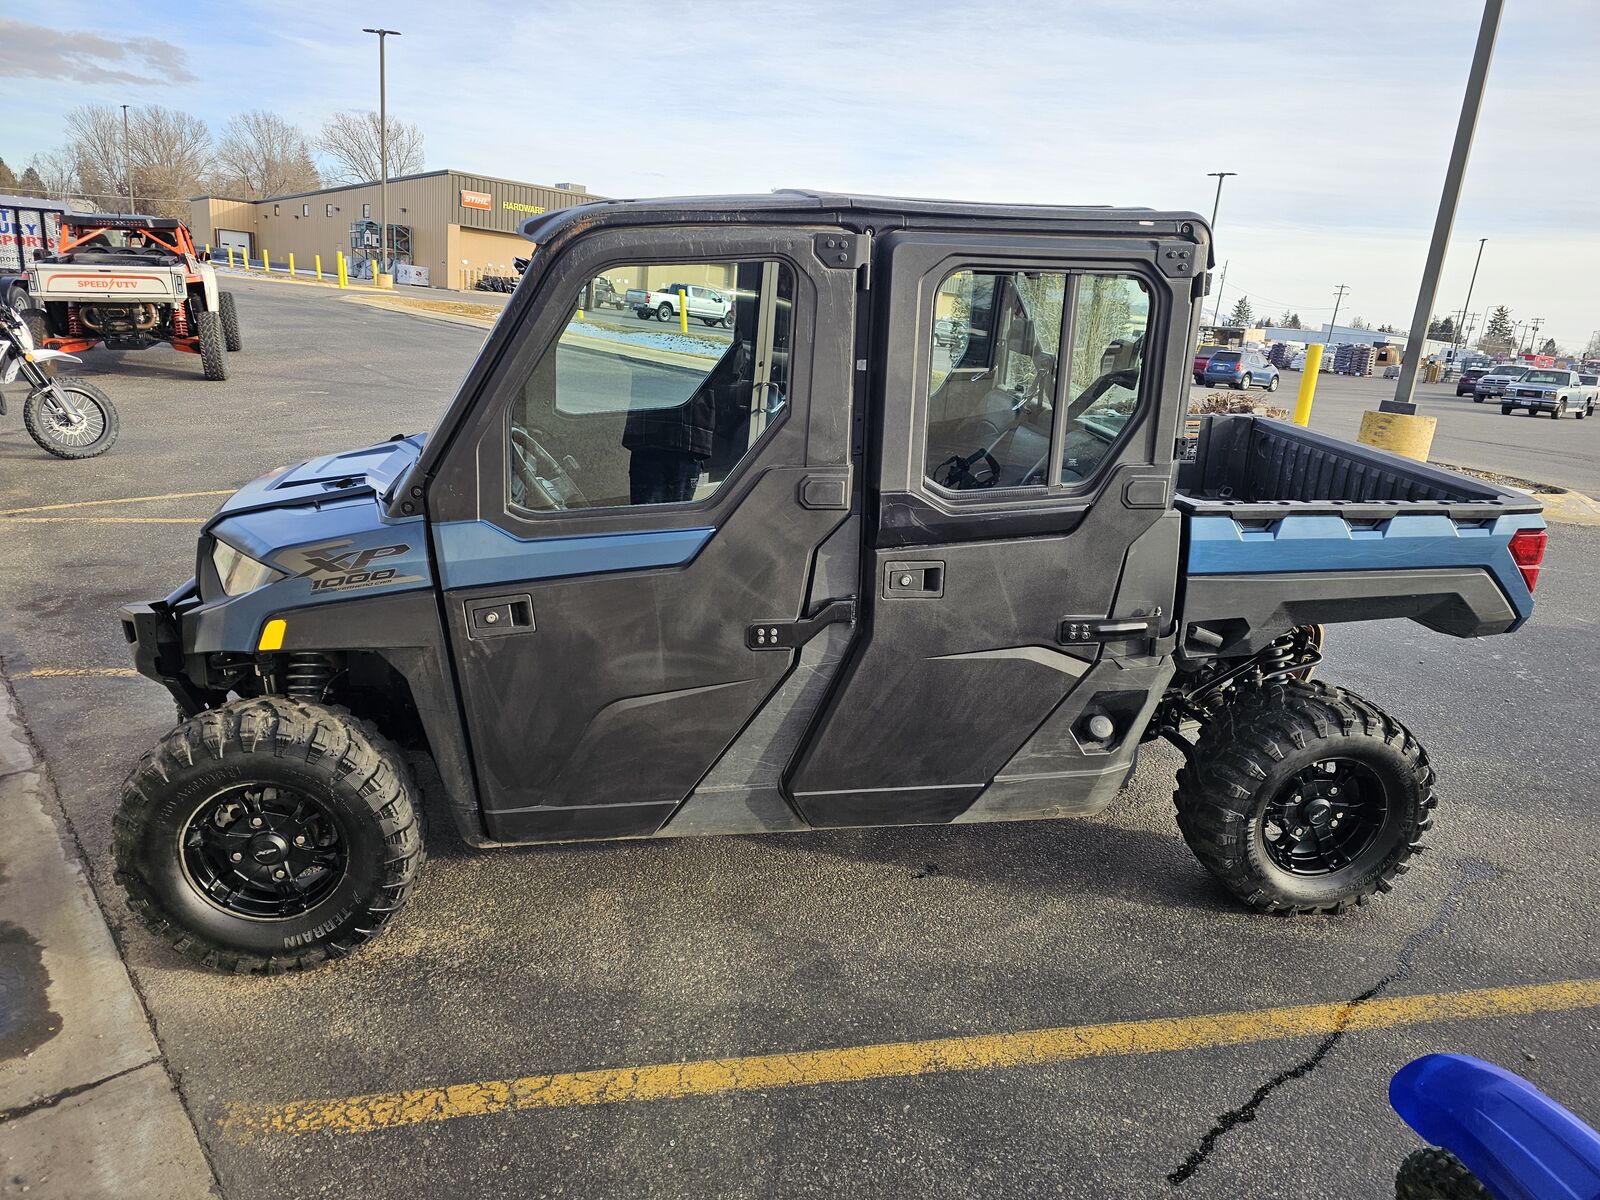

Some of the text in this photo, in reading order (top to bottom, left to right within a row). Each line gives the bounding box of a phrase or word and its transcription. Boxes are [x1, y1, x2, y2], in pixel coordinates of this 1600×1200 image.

[464, 195, 489, 205] STIHL
[502, 201, 546, 214] HARDWARE
[78, 280, 138, 289] SPEED UTV
[292, 543, 411, 579] XP
[311, 568, 397, 591] 1000
[283, 907, 353, 948] TERRAIN
